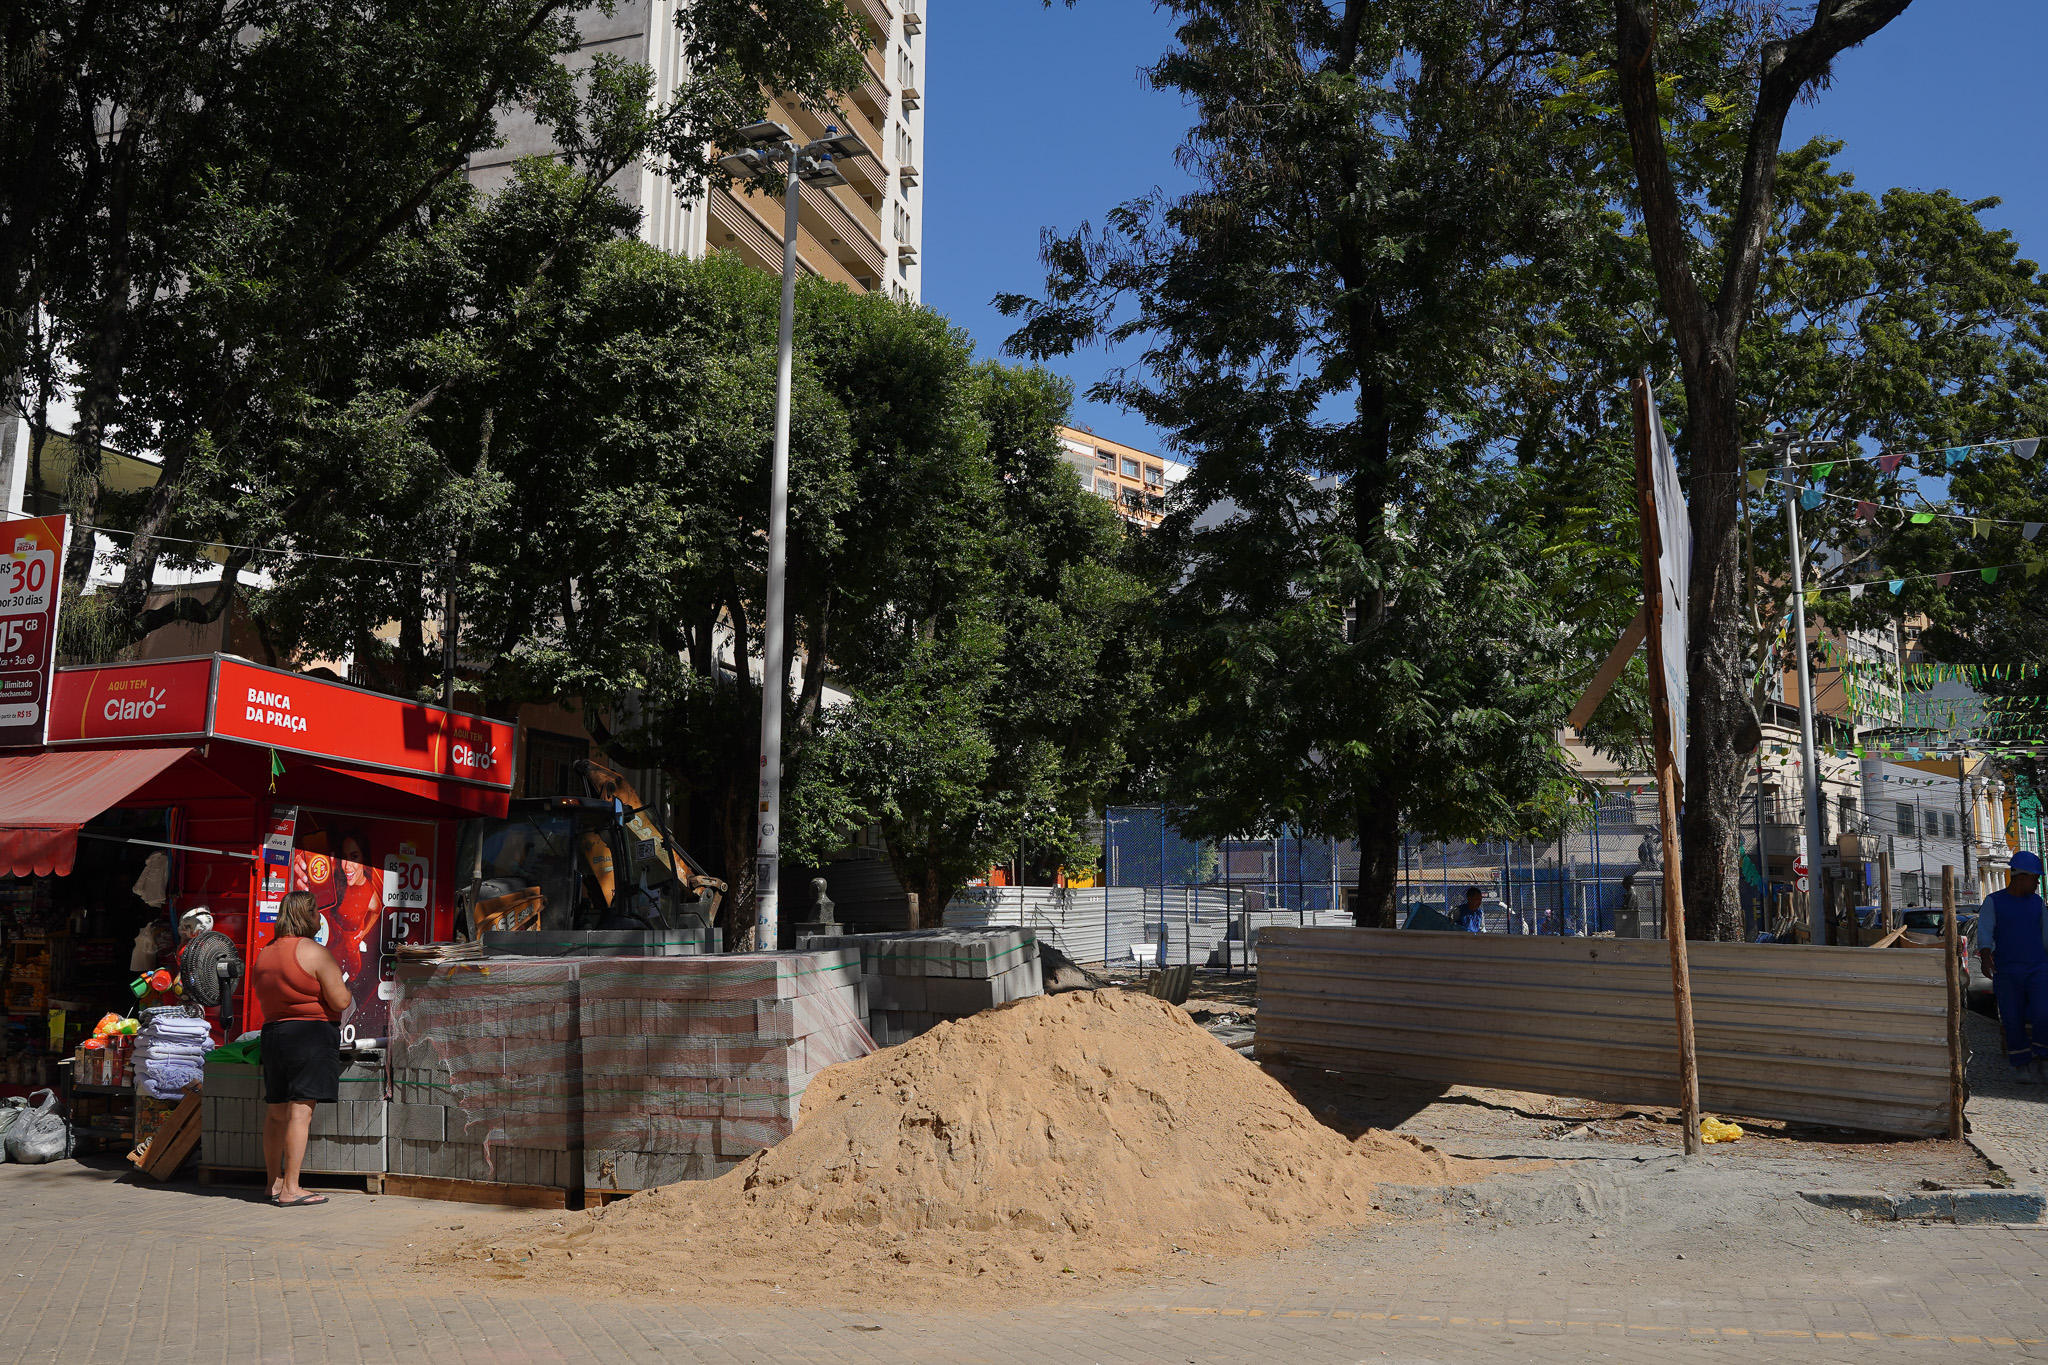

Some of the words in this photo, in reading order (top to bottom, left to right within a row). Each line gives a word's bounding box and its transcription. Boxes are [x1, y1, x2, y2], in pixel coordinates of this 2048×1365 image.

[9, 558, 46, 594] 30
[12, 595, 24, 607] 30
[25, 594, 43, 606] dias
[4, 679, 33, 689] ilimitado
[107, 680, 129, 691] AQUI
[130, 679, 147, 690] TEM
[104, 692, 160, 721] Claro
[247, 688, 291, 711] BANCA
[17, 710, 25, 719] R$
[25, 710, 32, 718] 15
[245, 706, 264, 724] DA
[266, 710, 307, 733] PRAÇA
[453, 728, 469, 740] AQUI
[470, 731, 483, 742] TEM
[452, 744, 493, 769] Claro
[398, 862, 424, 891] 30
[388, 892, 400, 901] por
[400, 891, 409, 901] 30
[410, 891, 423, 902] dias
[388, 911, 410, 939] 15
[410, 912, 420, 922] GB
[340, 1023, 356, 1044] 10
